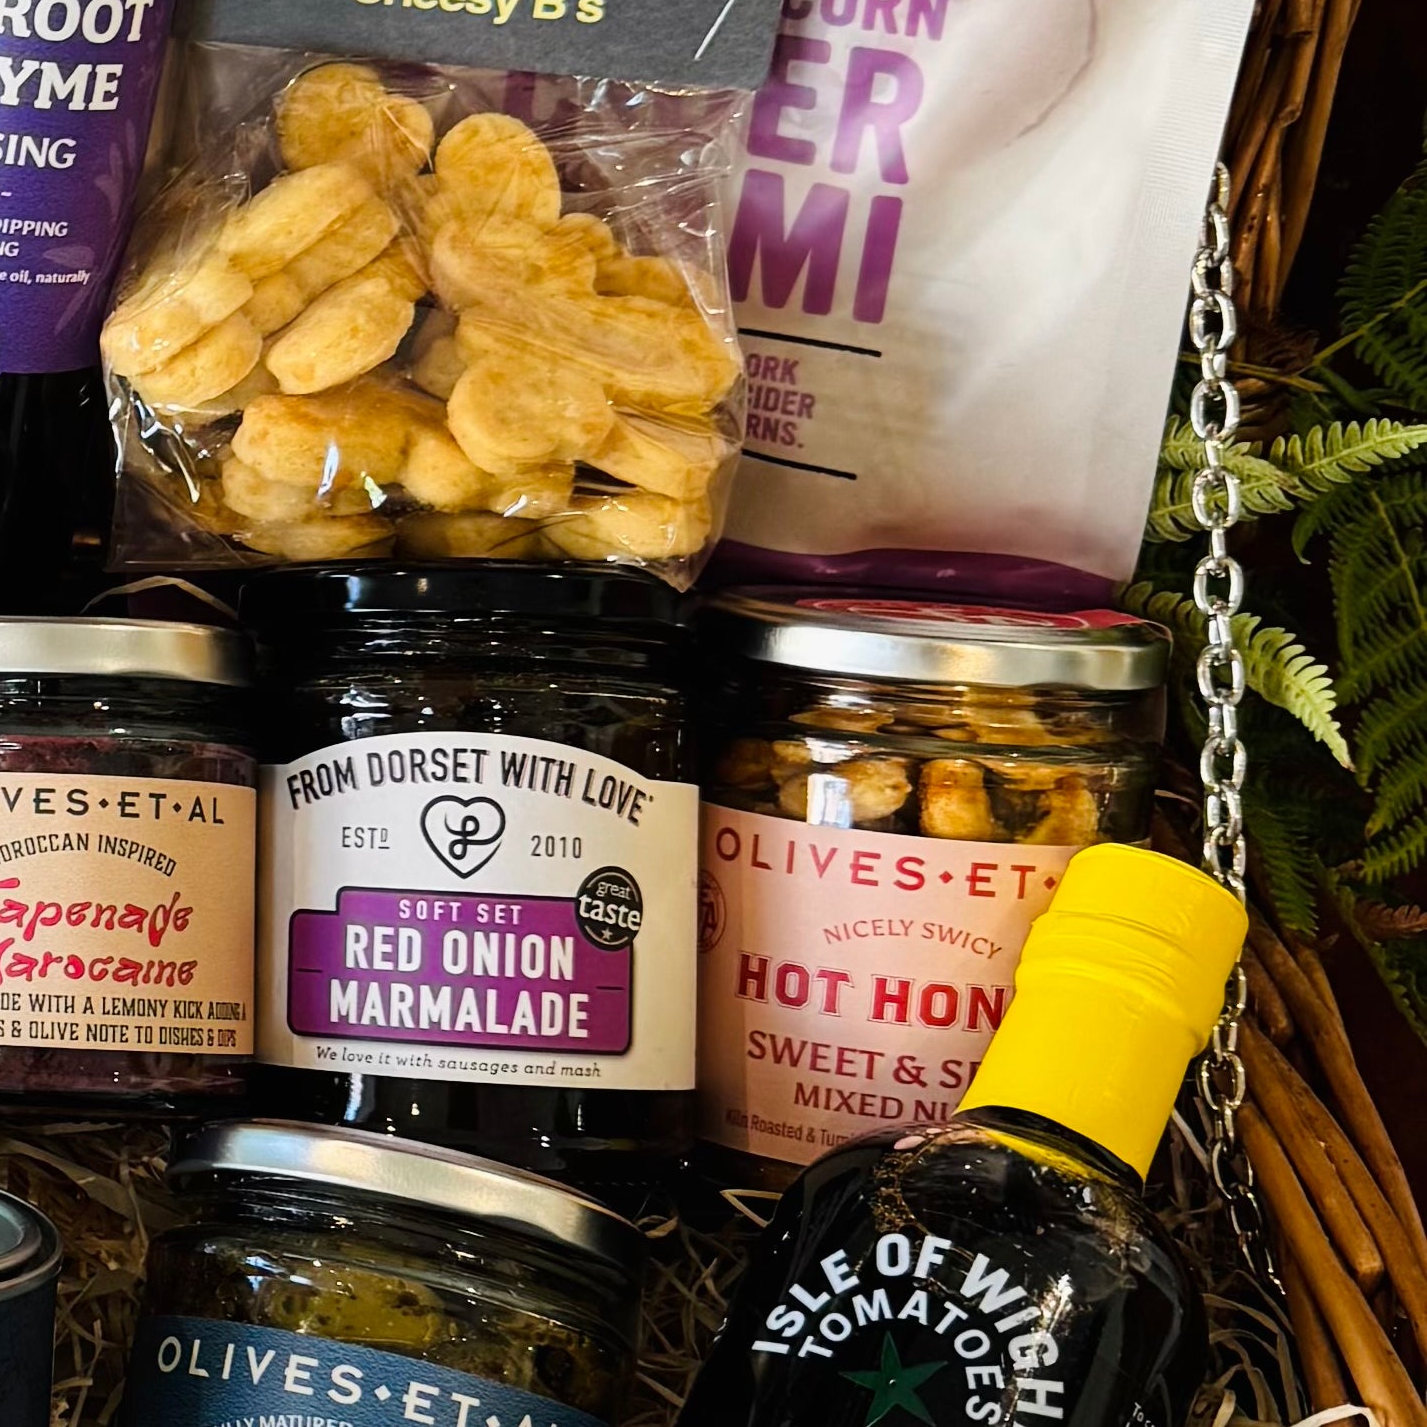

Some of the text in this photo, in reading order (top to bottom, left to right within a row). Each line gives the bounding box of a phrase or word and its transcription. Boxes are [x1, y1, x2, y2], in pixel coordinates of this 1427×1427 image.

[98, 835, 177, 877] INSPIRED
[346, 925, 574, 980] RED ONION
[330, 979, 588, 1038] MARMALADE
[735, 950, 855, 1016] HOT
[316, 1046, 601, 1078] We love it with sausages and mash
[748, 1030, 884, 1079] SWEET
